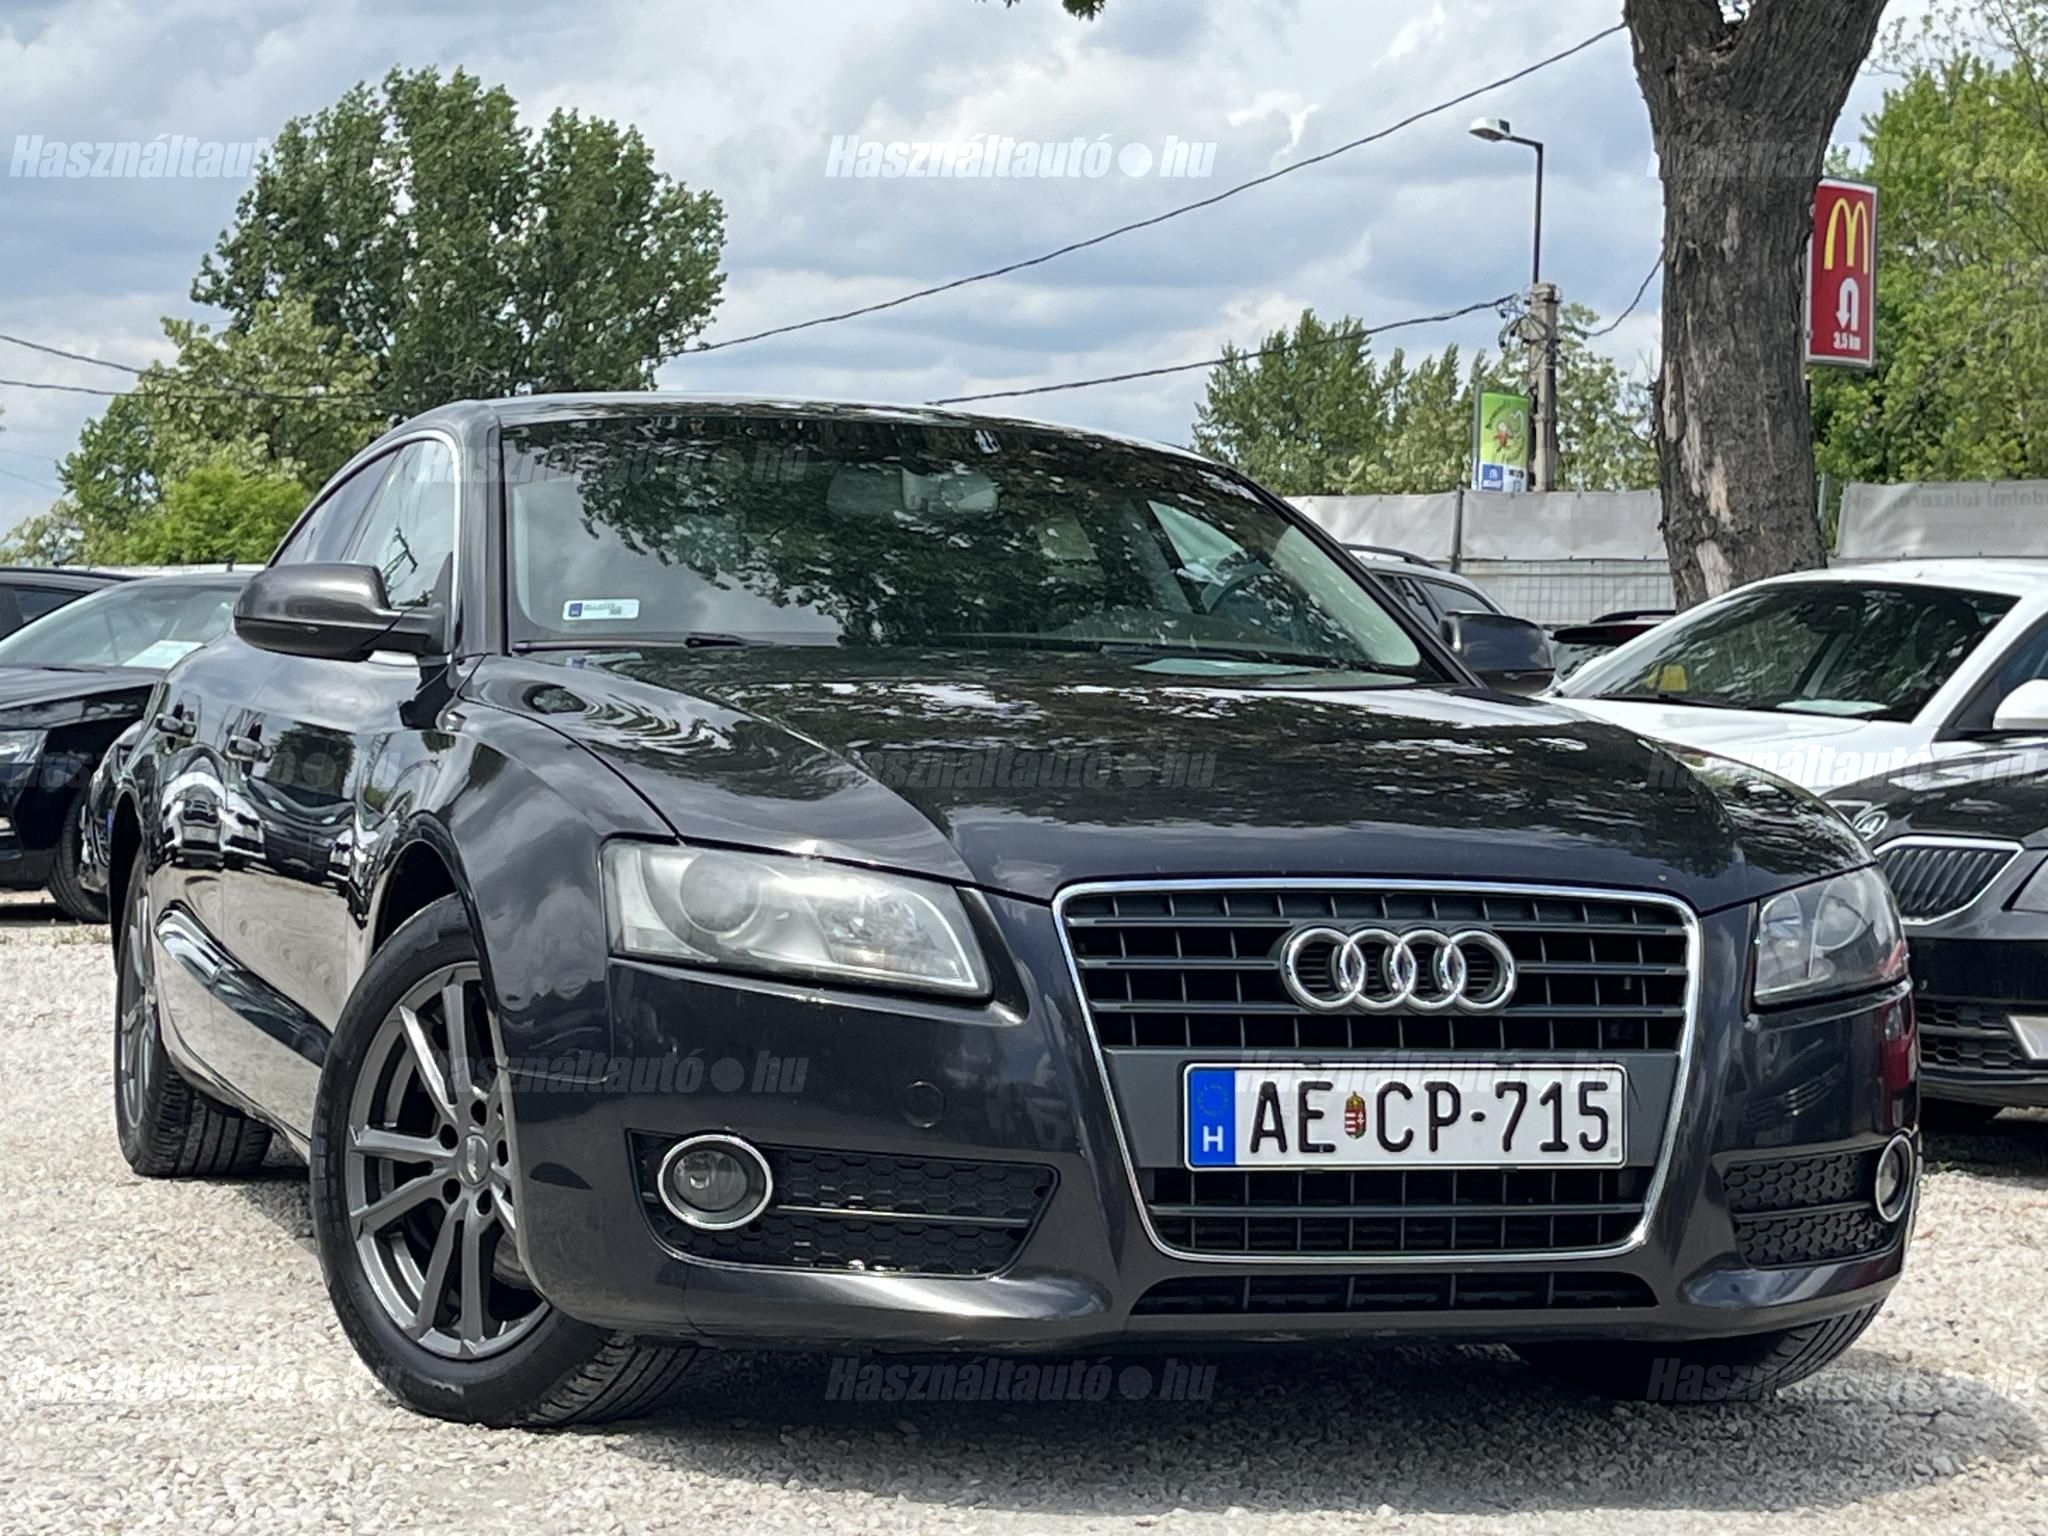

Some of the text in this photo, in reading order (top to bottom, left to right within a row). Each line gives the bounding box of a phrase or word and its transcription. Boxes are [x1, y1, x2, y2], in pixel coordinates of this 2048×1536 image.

[1202, 1080, 1609, 1153] H AE CP-715
